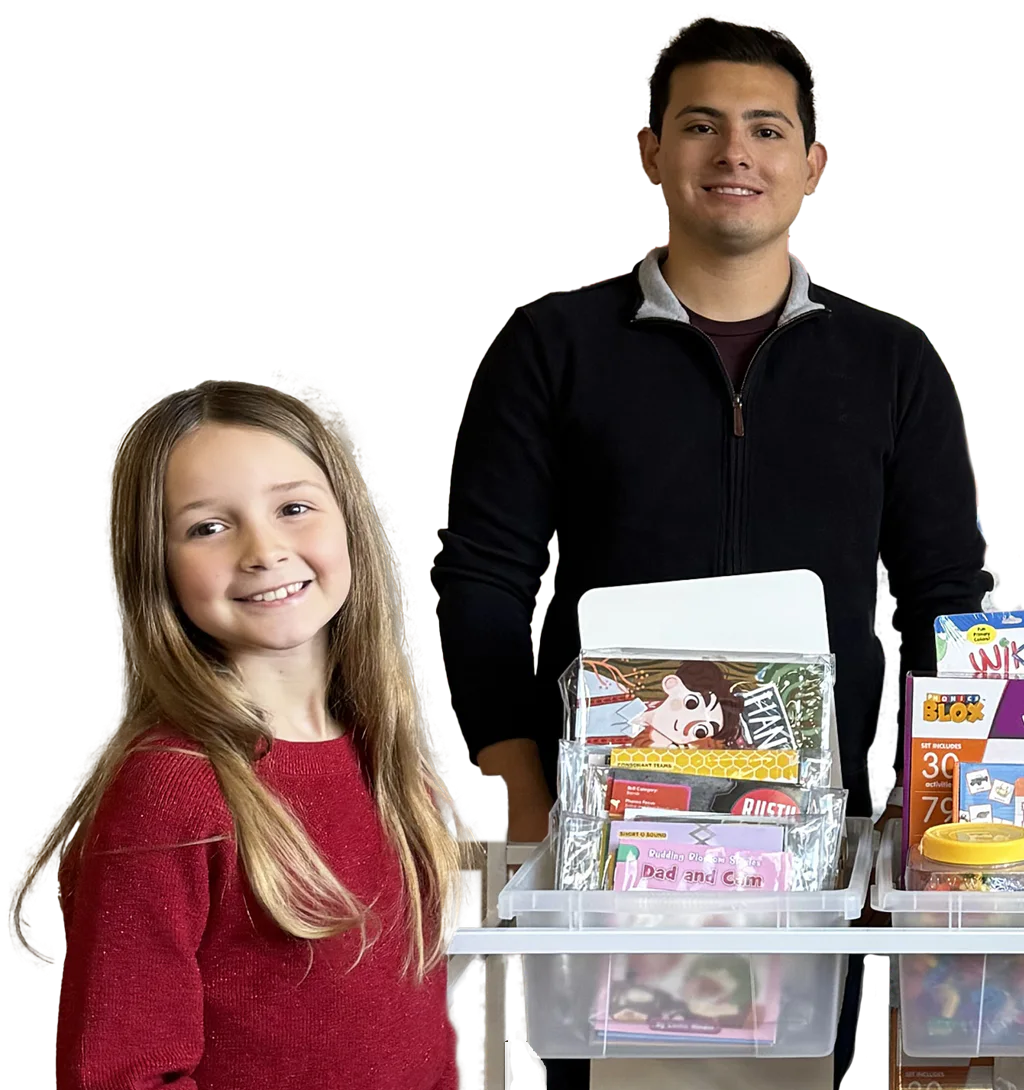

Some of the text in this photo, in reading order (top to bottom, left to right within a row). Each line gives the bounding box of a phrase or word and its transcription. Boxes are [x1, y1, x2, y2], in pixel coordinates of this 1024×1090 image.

[926, 693, 980, 702] PHONICS
[923, 701, 985, 723] BLOX
[922, 752, 959, 779] 30
[689, 850, 726, 864] Bloom
[642, 864, 677, 881] Dad
[685, 868, 716, 884] and
